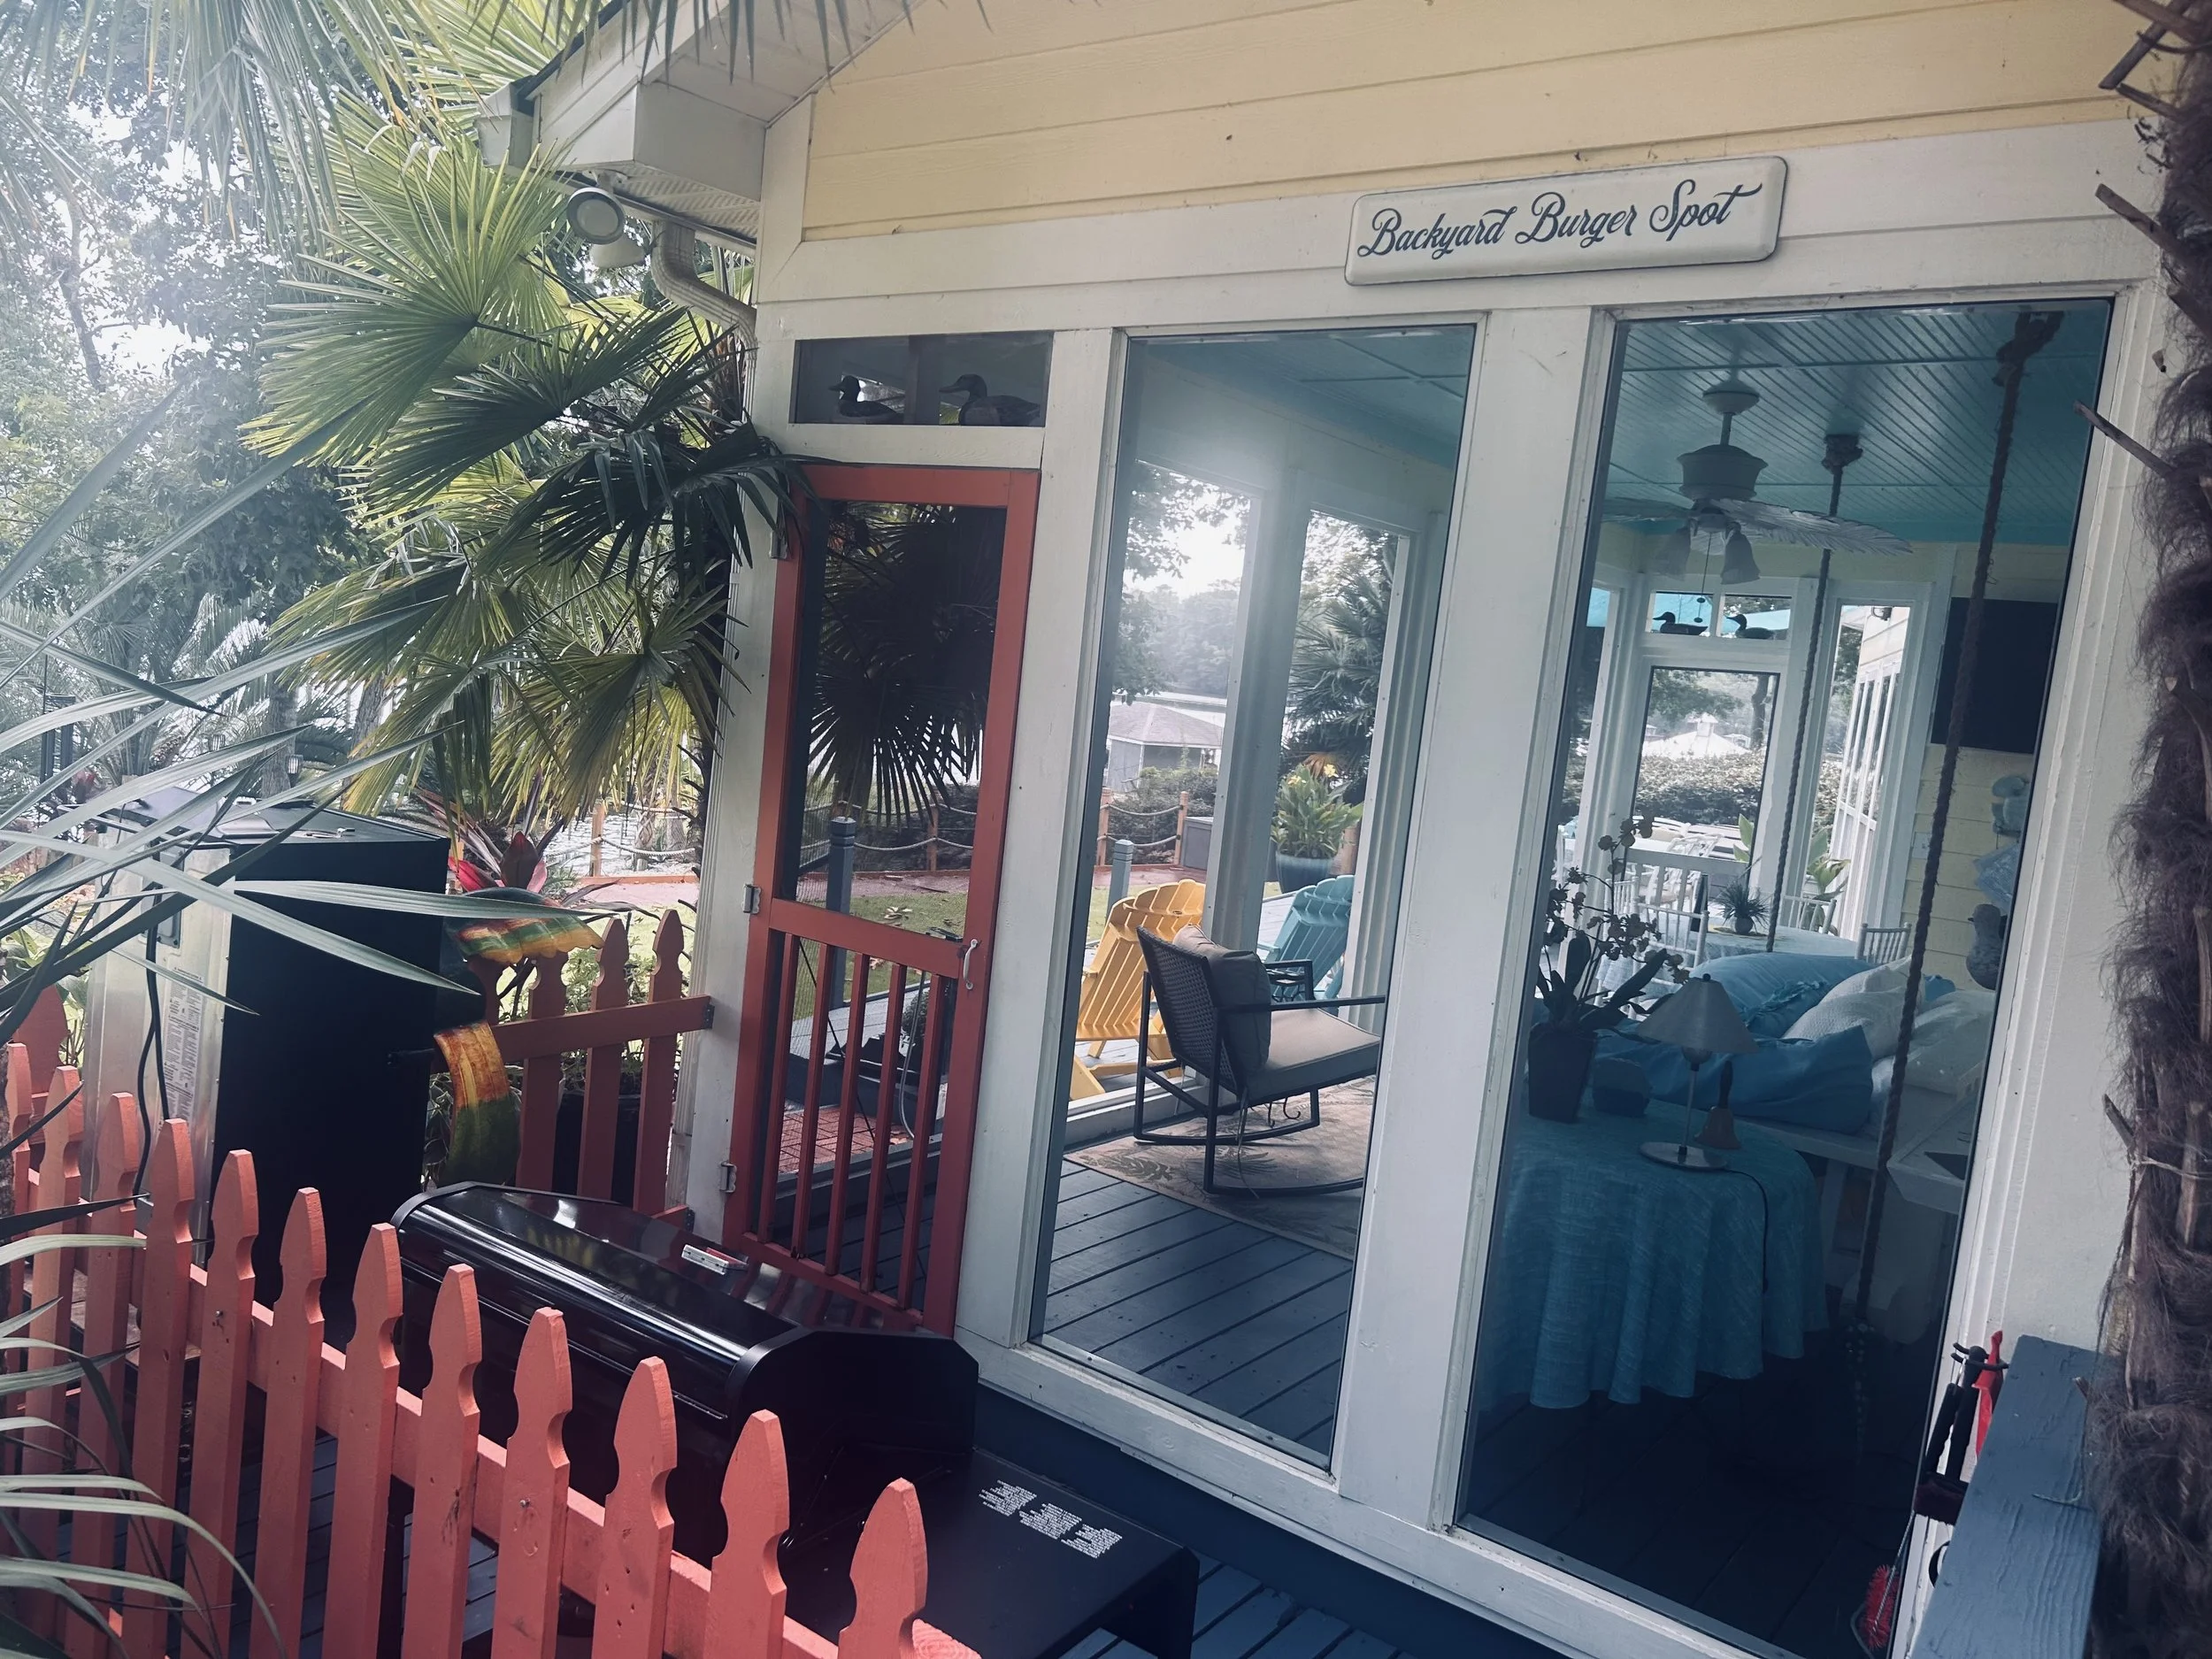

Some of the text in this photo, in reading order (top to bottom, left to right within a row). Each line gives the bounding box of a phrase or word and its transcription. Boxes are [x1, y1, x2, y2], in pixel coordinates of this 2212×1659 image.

[1357, 179, 1763, 259] Backyard Burger Spot
